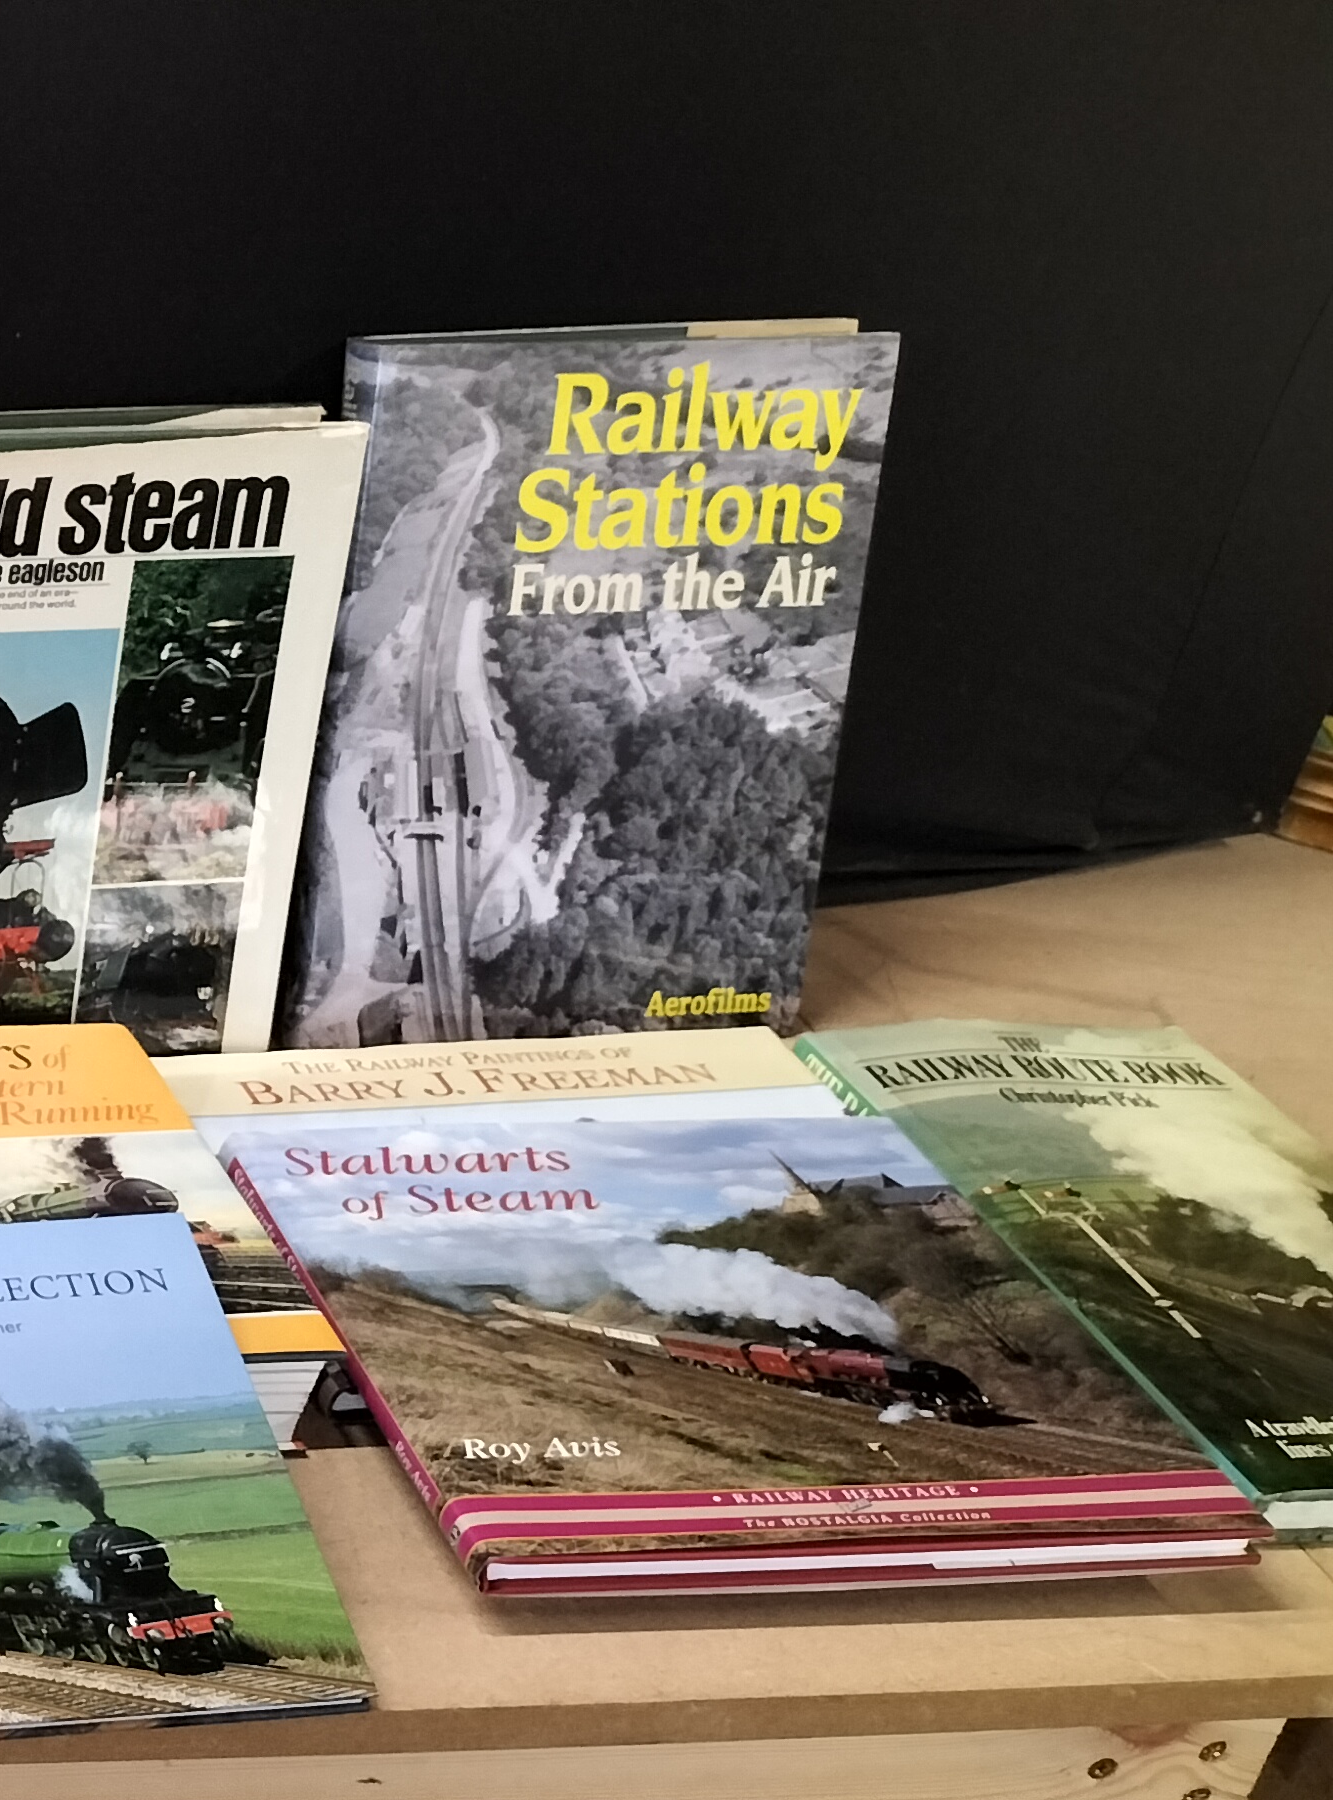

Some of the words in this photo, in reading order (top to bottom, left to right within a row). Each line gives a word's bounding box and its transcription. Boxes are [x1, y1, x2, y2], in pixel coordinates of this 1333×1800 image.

[545, 360, 864, 471] Railway
[58, 472, 292, 557] steam
[514, 462, 845, 553] Stations
[8, 559, 106, 587] eagleson
[506, 562, 644, 617] From
[662, 552, 746, 611] the
[755, 552, 837, 609] Air
[7, 590, 27, 599] end
[644, 987, 772, 1018] Aerofilms
[41, 1043, 72, 1073] of
[280, 1058, 341, 1078] THE
[349, 1052, 456, 1075] RAILWAY
[461, 1048, 594, 1069] PAINTINGS
[598, 1044, 632, 1061] OF
[863, 1055, 1013, 1091] RAILWAY
[1011, 1055, 1130, 1084] ROUTE
[1121, 1060, 1226, 1088] BOOK
[236, 1077, 408, 1107] BARRY
[423, 1072, 467, 1098] J.
[473, 1063, 717, 1095] FREEMAN
[999, 1087, 1112, 1108] Christopher
[0, 1097, 161, 1128] Running
[284, 1144, 572, 1178] Stalwarts
[341, 1190, 388, 1222] of
[407, 1184, 600, 1214] Steam
[1244, 1418, 1270, 1438] A
[463, 1437, 531, 1465] Roy
[543, 1436, 622, 1459] Avis
[733, 1489, 833, 1505] RAILWAY
[840, 1485, 961, 1501] HERITAGE
[743, 1519, 776, 1529] The
[782, 1513, 894, 1527] NOSTALGIA
[900, 1510, 992, 1523] Collection
